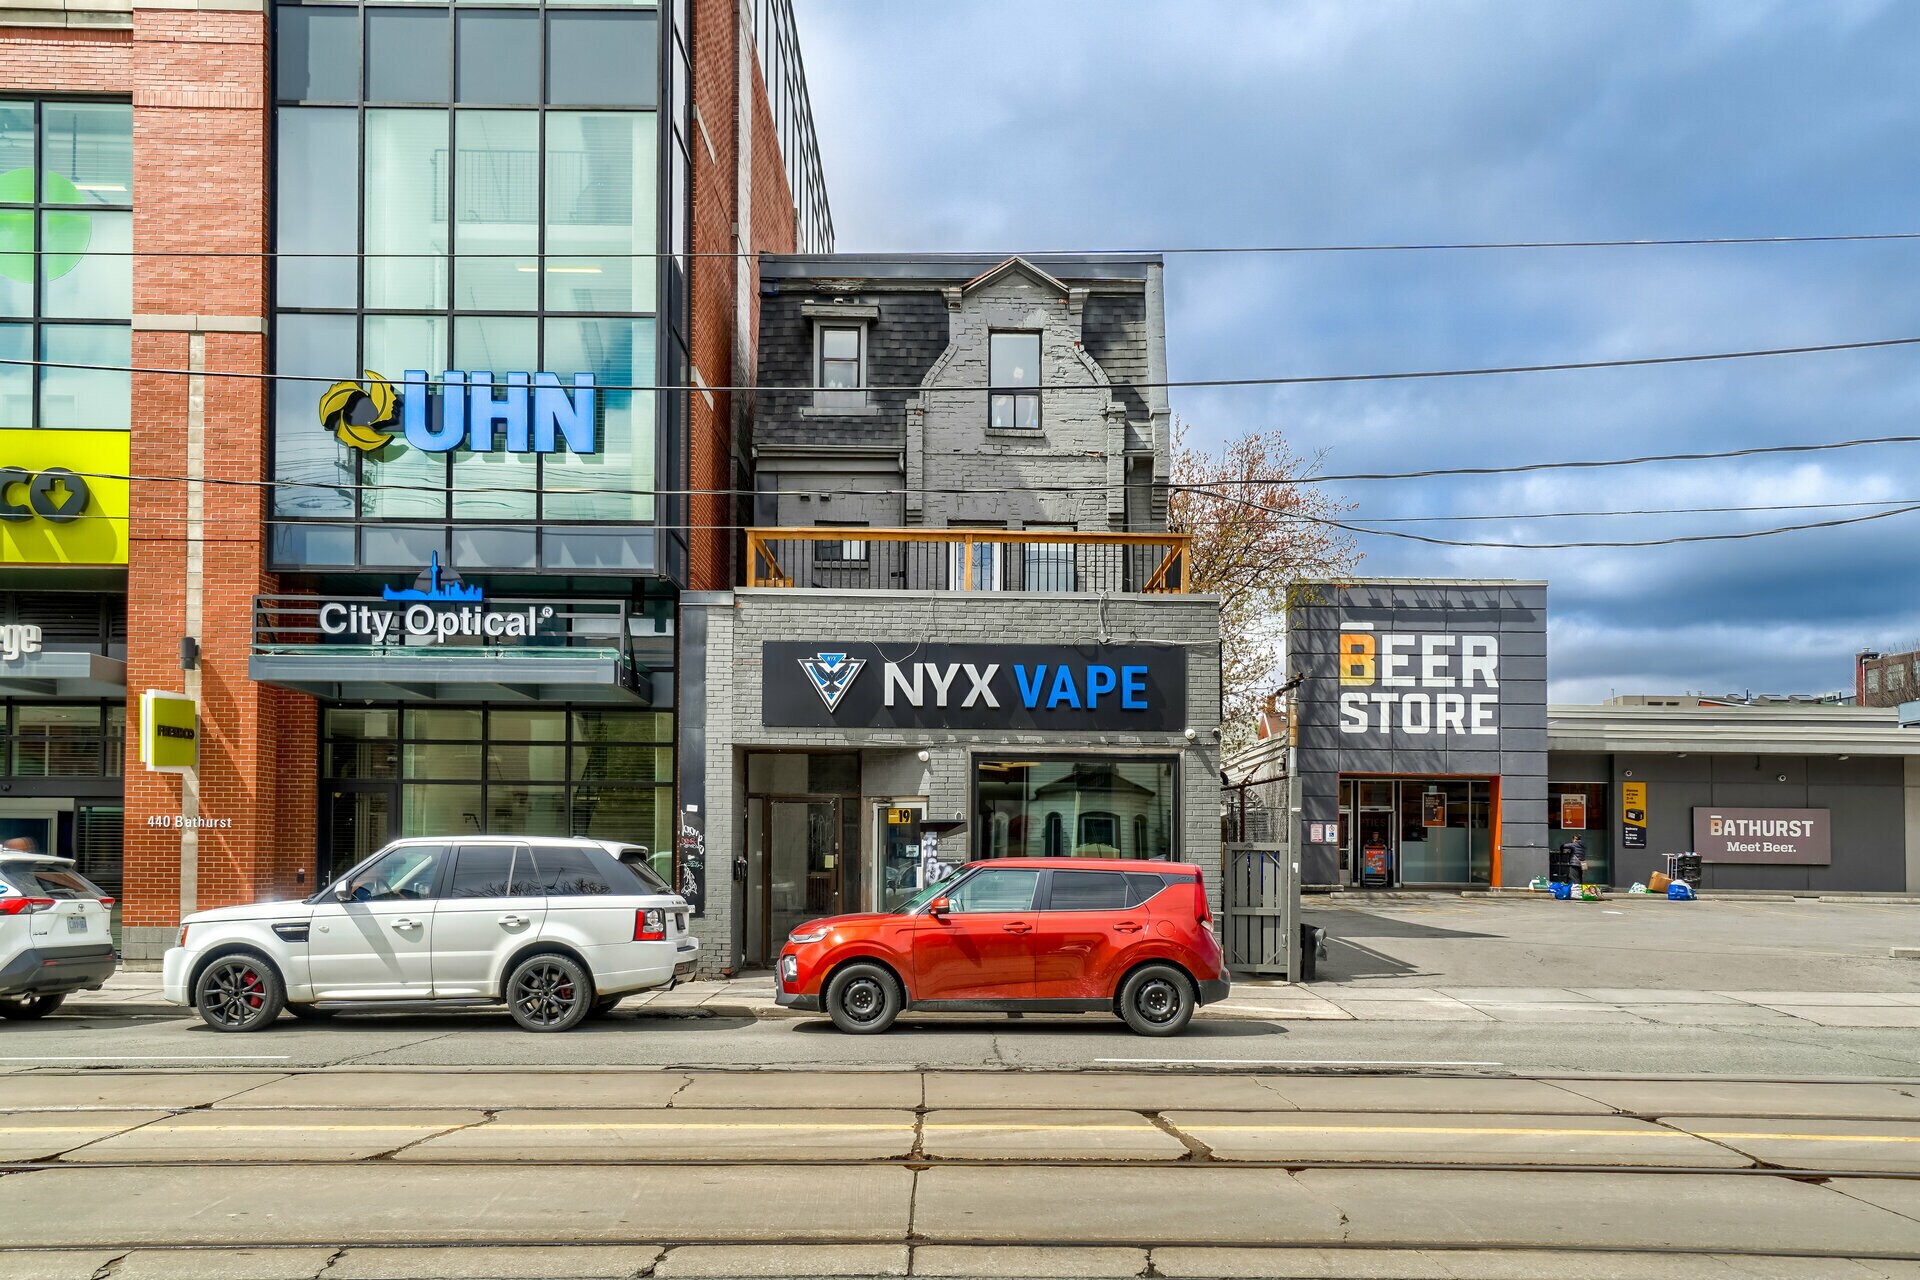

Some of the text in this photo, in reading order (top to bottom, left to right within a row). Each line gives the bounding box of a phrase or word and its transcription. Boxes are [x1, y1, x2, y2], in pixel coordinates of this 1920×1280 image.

[404, 370, 595, 454] UHN
[320, 603, 393, 642] City
[0, 625, 42, 661] ge
[1340, 632, 1499, 688] BEER
[884, 662, 1148, 710] NYX VAPE
[1340, 692, 1498, 735] STORE
[147, 815, 232, 828] 440 Bathurst
[898, 809, 910, 823] 19
[1710, 819, 1814, 838] BATHURST
[1727, 841, 1797, 852] Meet Beer.
